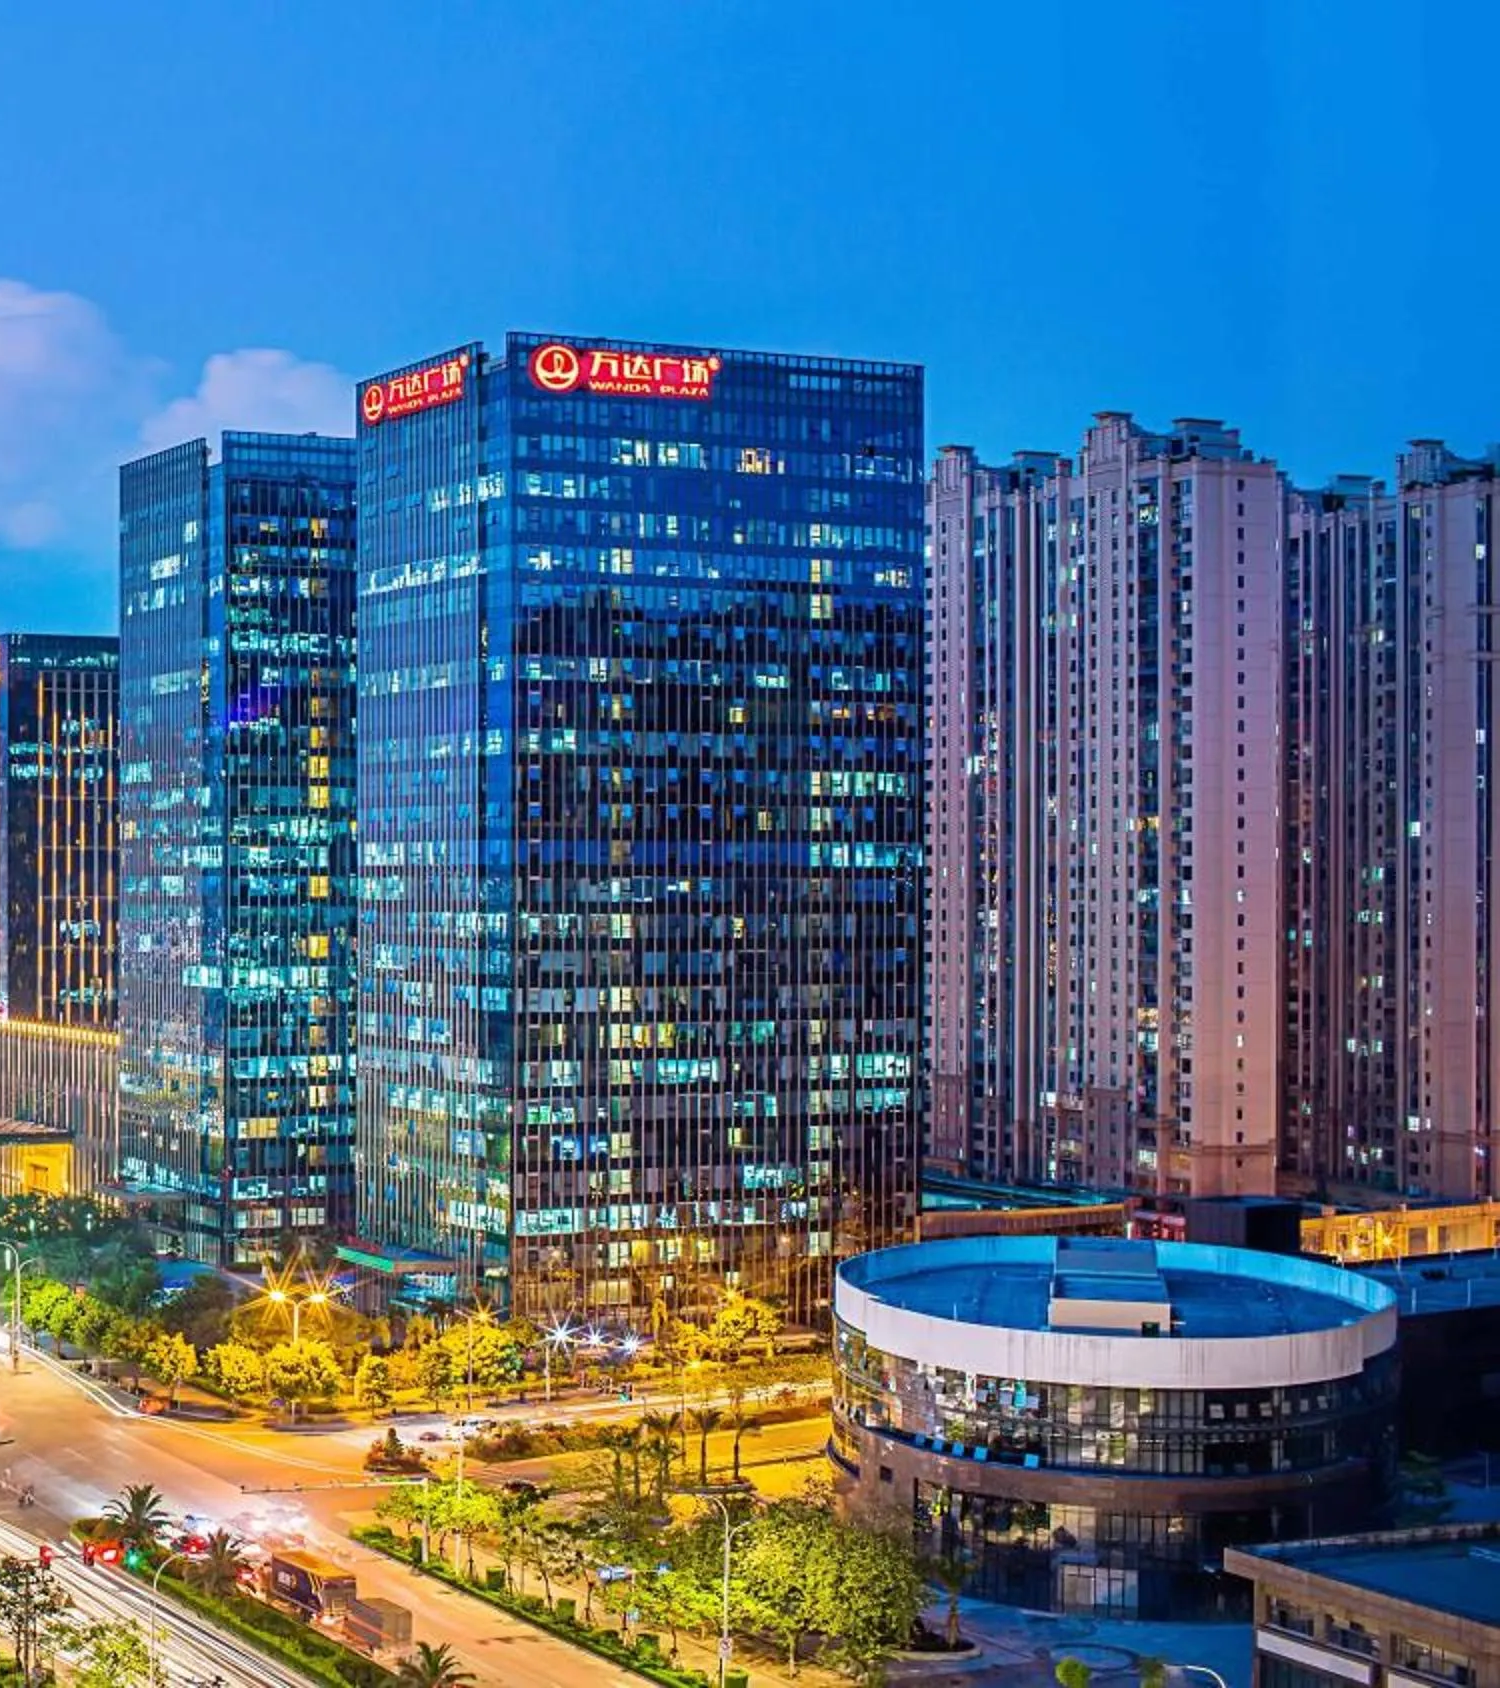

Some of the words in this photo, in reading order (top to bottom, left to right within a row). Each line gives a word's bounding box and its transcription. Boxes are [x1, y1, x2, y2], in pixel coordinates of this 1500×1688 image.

[388, 360, 461, 402] 万达广场
[589, 351, 709, 384] 万达广场
[589, 380, 652, 394] WANDA
[659, 385, 709, 397] PLAZA
